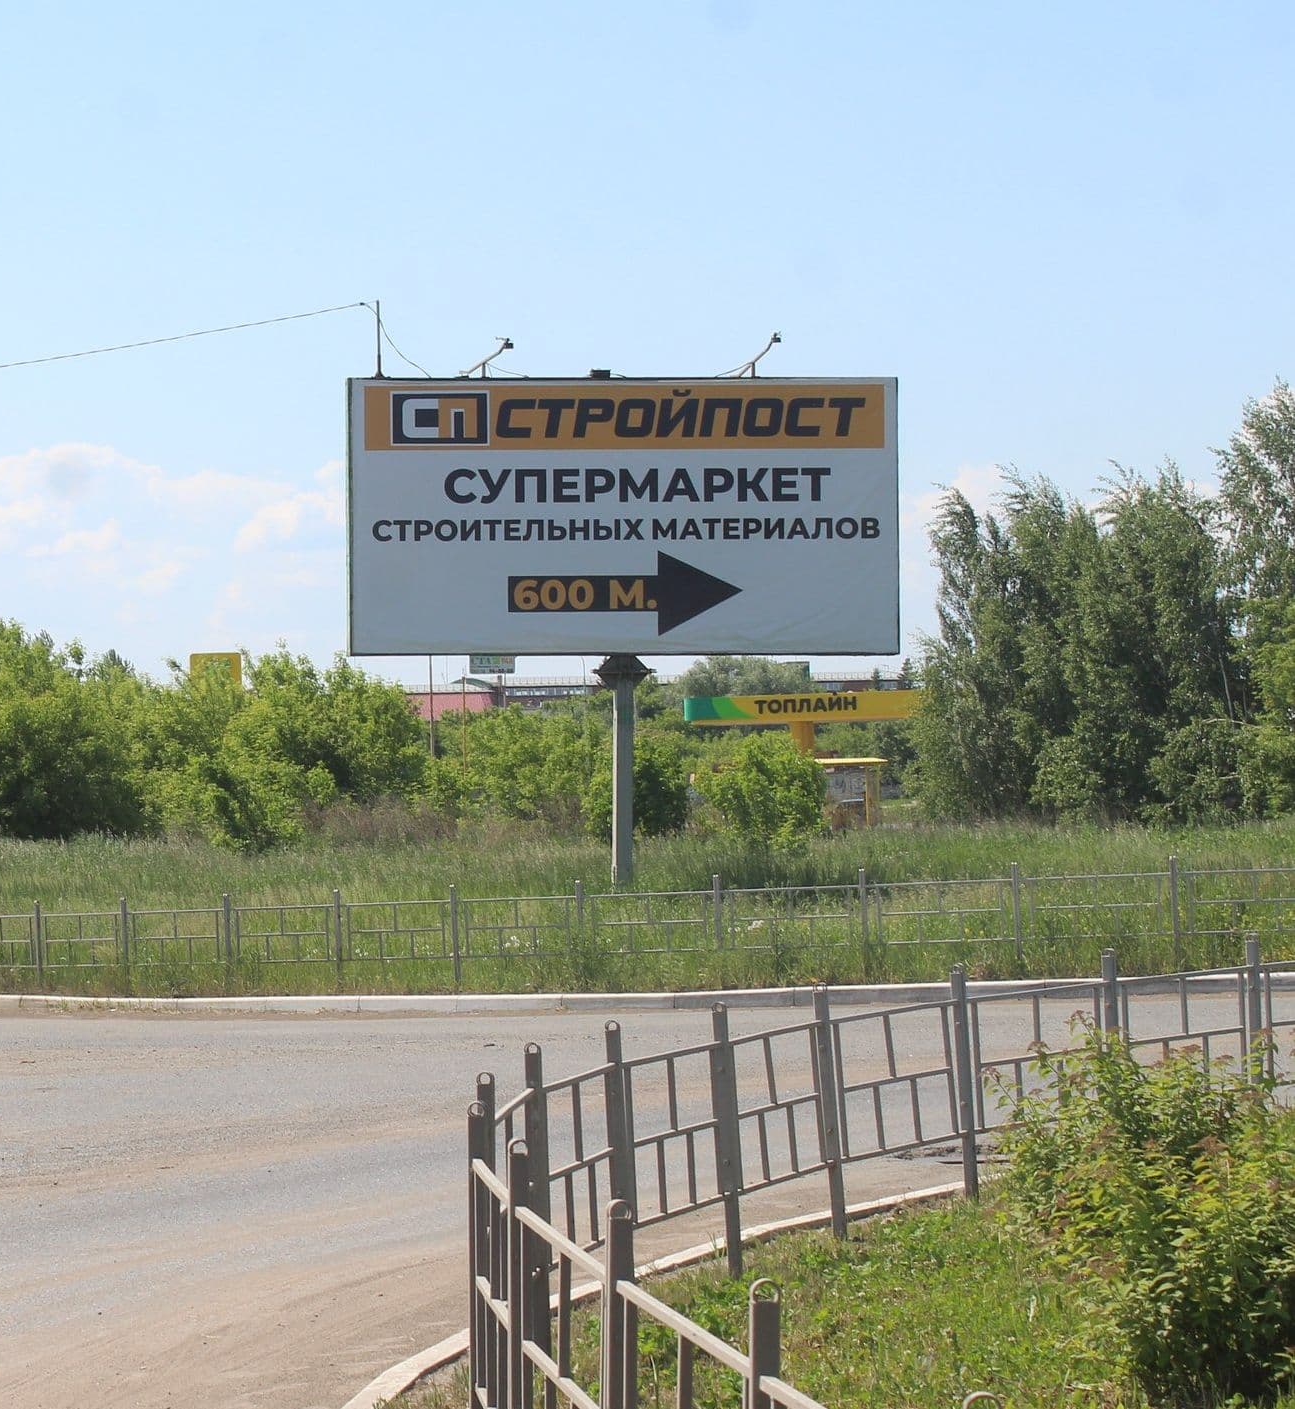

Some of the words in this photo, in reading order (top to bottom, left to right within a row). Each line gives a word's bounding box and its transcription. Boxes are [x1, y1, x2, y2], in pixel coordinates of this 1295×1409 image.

[497, 389, 866, 438] СТРОЙПОСТ
[444, 467, 831, 503] СУПЕРМАРКЕТ
[372, 519, 644, 542] СТРОИТЕЛЬНЫХ
[652, 517, 880, 540] МАТЕРИАЛОВ
[513, 579, 594, 611] 600
[610, 580, 658, 610] М.
[754, 691, 857, 714] ТОПЛАЙН
